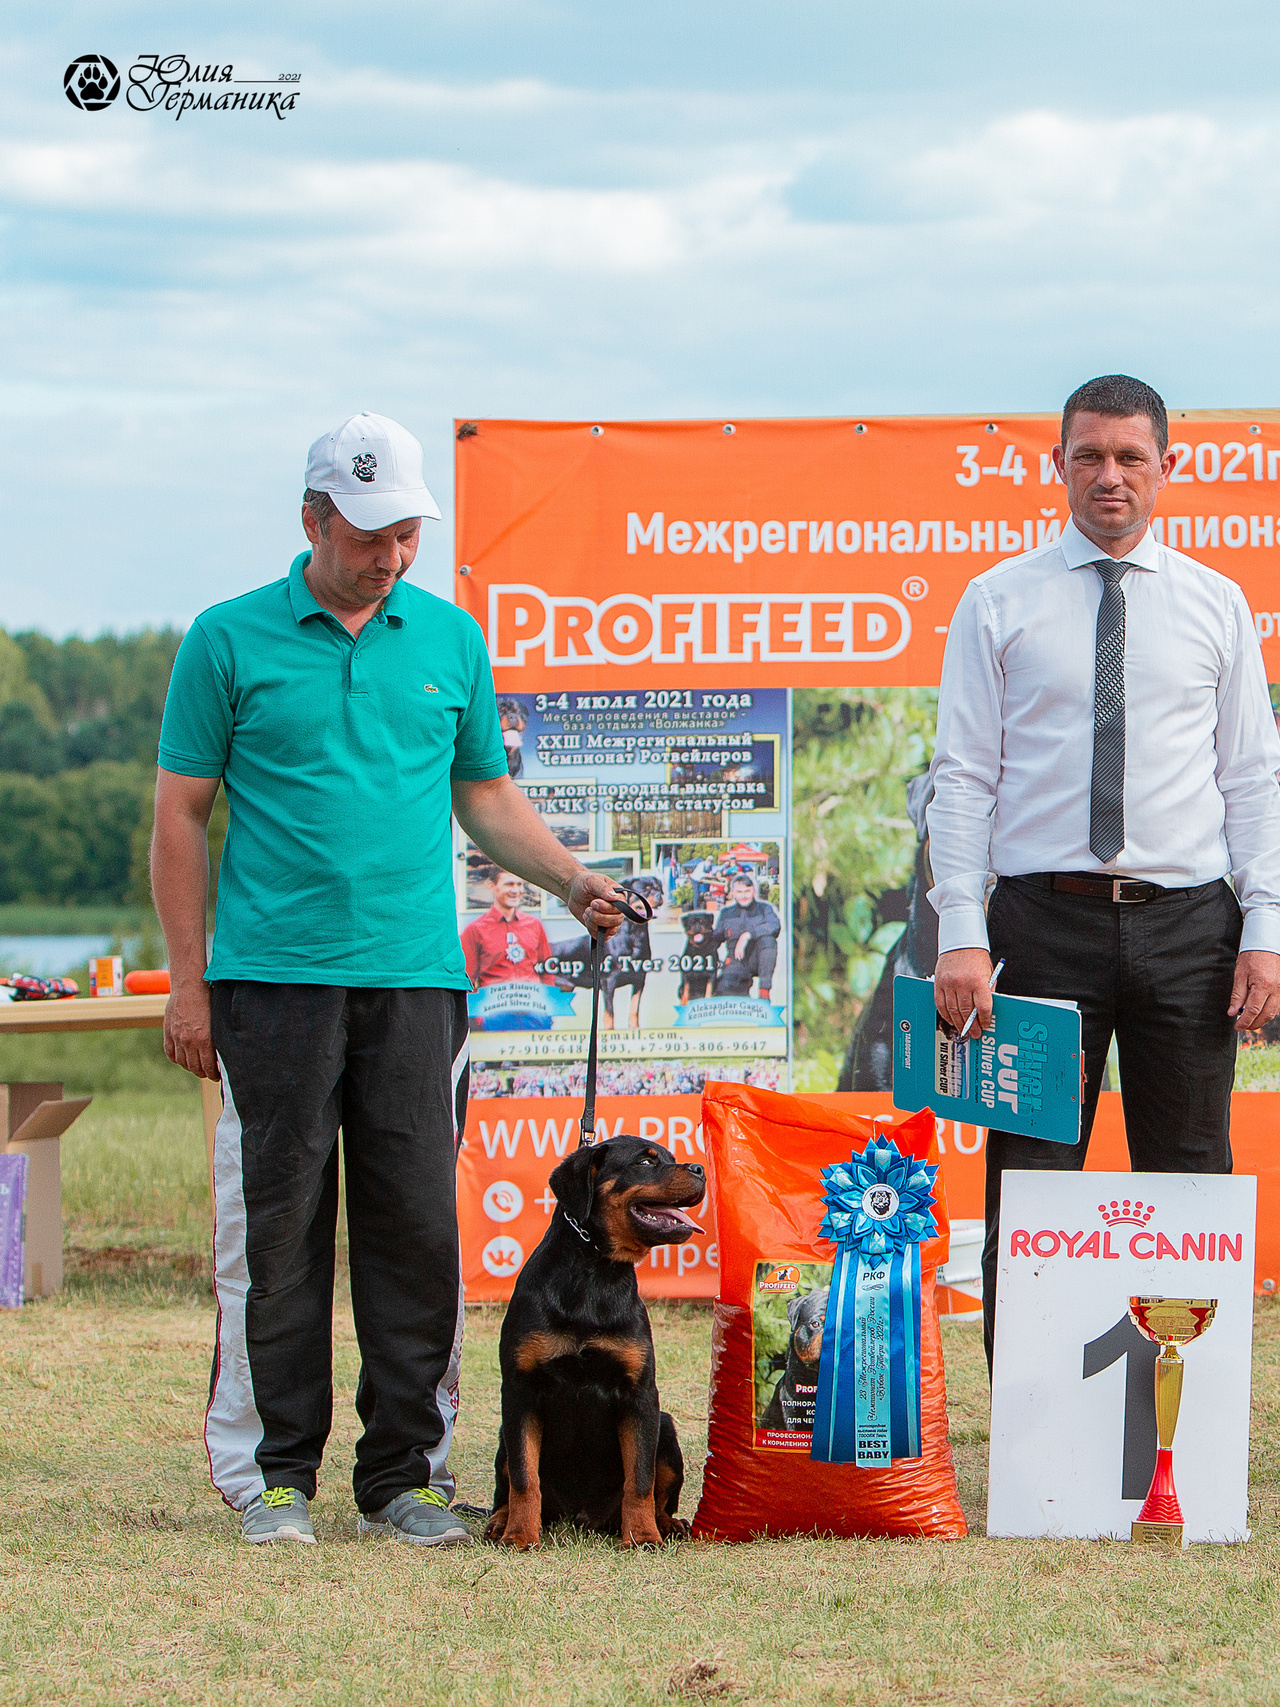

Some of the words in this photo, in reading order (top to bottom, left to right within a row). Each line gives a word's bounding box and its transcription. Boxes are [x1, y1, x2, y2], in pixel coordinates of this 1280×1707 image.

[955, 445, 1027, 487] 3-4
[626, 509, 1062, 564] Межрегиональный
[490, 587, 908, 664] PROFIFEED
[535, 692, 569, 712] 3-4
[576, 694, 638, 710] июля
[644, 690, 694, 709] 2021
[702, 692, 753, 710] года
[543, 713, 582, 723] Место
[588, 711, 668, 722] проведения
[674, 710, 736, 720] выставок
[563, 721, 592, 731] база
[597, 721, 644, 731] отдыха
[649, 719, 725, 730] «Волжанка»
[587, 731, 753, 750] Межрегиональный
[537, 751, 634, 766] Чемпионат
[639, 748, 753, 767] Ротвейлеров
[554, 783, 680, 799] монопородная
[685, 782, 766, 796] выставка
[604, 797, 669, 813] особым
[675, 798, 754, 816] статусом
[533, 957, 584, 978] «Cup
[618, 955, 663, 973] Tver
[980, 1035, 996, 1077] Silver
[939, 1077, 948, 1094] CUP
[980, 1079, 996, 1109] CUP
[1010, 1229, 1120, 1260] ROYAL
[1128, 1231, 1243, 1262] CANIN
[862, 1271, 886, 1281] РКФ
[1083, 1311, 1161, 1500] 1
[858, 1440, 888, 1448] BEST
[858, 1450, 889, 1459] BABY
